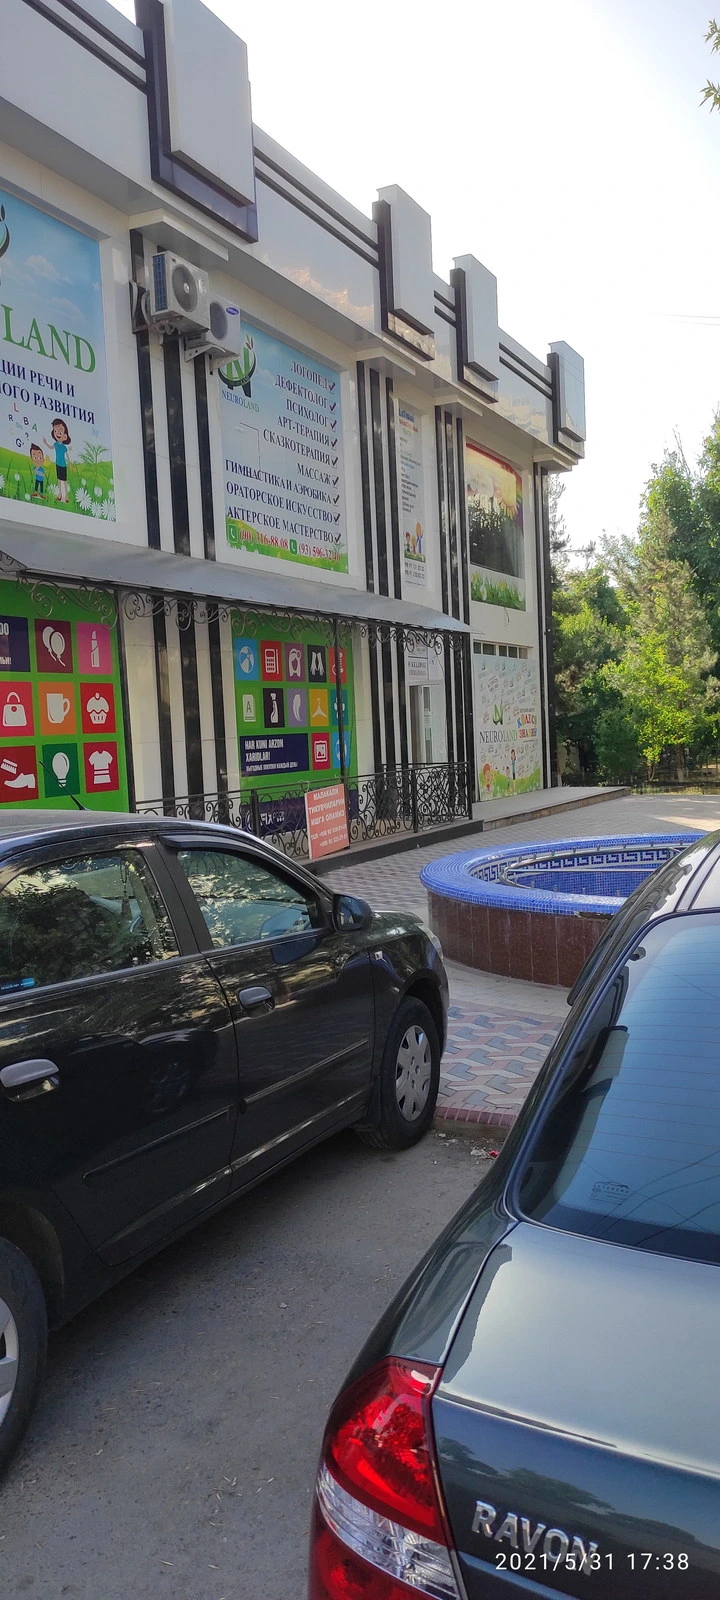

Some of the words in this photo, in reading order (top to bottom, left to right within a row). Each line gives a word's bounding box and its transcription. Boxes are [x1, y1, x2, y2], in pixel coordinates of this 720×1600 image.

[1, 303, 96, 373] LAND
[30, 369, 63, 393] РЕЧИ
[66, 382, 75, 398] И
[275, 373, 328, 408] ДЕФЕКТОЛОГ
[291, 360, 328, 389] ЛОГОПЕД
[0, 382, 30, 403] ОГО
[33, 392, 95, 425] РАЗВИТИЯ
[221, 389, 260, 413] NEUROLAND
[286, 398, 328, 428] ПСИХОЛОГ
[263, 428, 330, 465] СКАЗКОТЕРАПИЯ
[277, 415, 330, 447] АРТ-ТЕРАПИЯ
[225, 458, 285, 489] ГИМНАСТИКА
[286, 480, 292, 491] И
[294, 482, 332, 504] АЭРОБИКА
[297, 462, 331, 485] МАССАЖ
[226, 481, 284, 508] ОРАТОРСКОЕ
[285, 498, 333, 524] ИСКУССТВО
[227, 506, 281, 530] АКТЕРСКОЕ
[282, 519, 334, 544] МАСТЕРСТВО
[245, 740, 255, 750] HAR
[268, 738, 284, 749] ARZON
[480, 729, 518, 744] NEUROLAND
[246, 752, 270, 763] XARIDLAR!
[471, 1500, 600, 1576] RAVON
